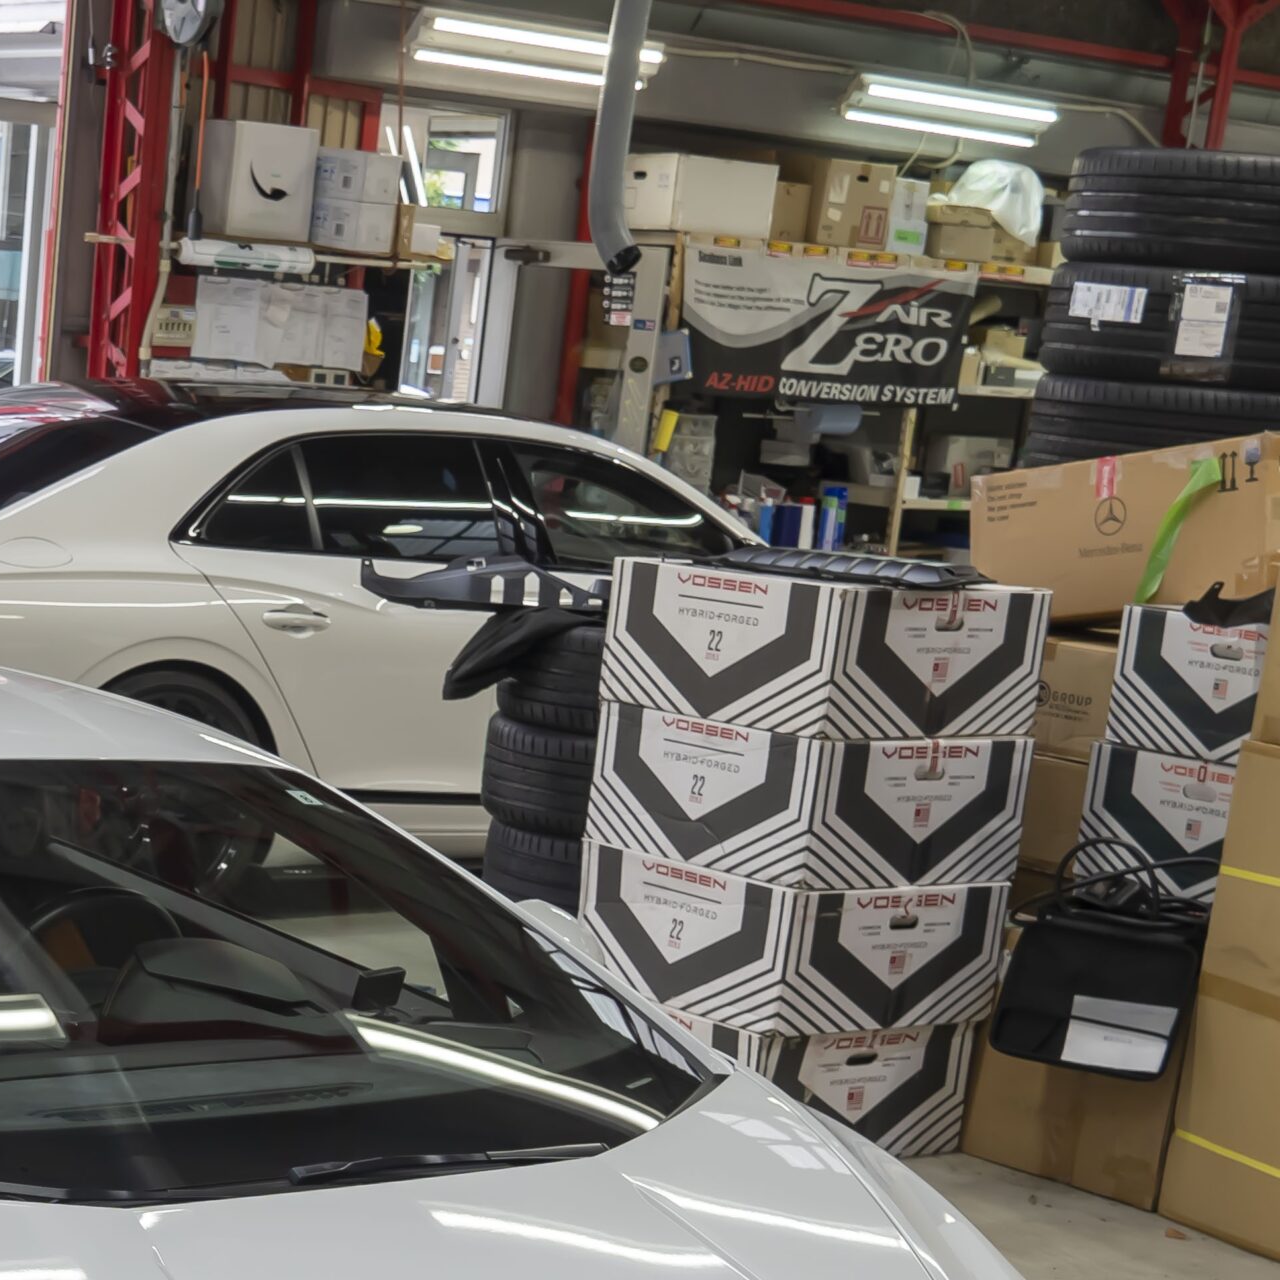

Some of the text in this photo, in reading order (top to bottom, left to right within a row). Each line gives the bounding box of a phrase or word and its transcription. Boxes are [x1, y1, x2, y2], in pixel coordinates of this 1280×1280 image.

[705, 371, 955, 405] AZ-HID CONVERSION SYSTEM
[677, 572, 769, 596] VOSSEN
[707, 629, 724, 652] 22
[1051, 690, 1093, 707] GROUP
[662, 715, 750, 743] VOSSEN
[690, 774, 706, 796] 22
[642, 859, 727, 891] VOSSEN
[669, 918, 685, 941] 22
